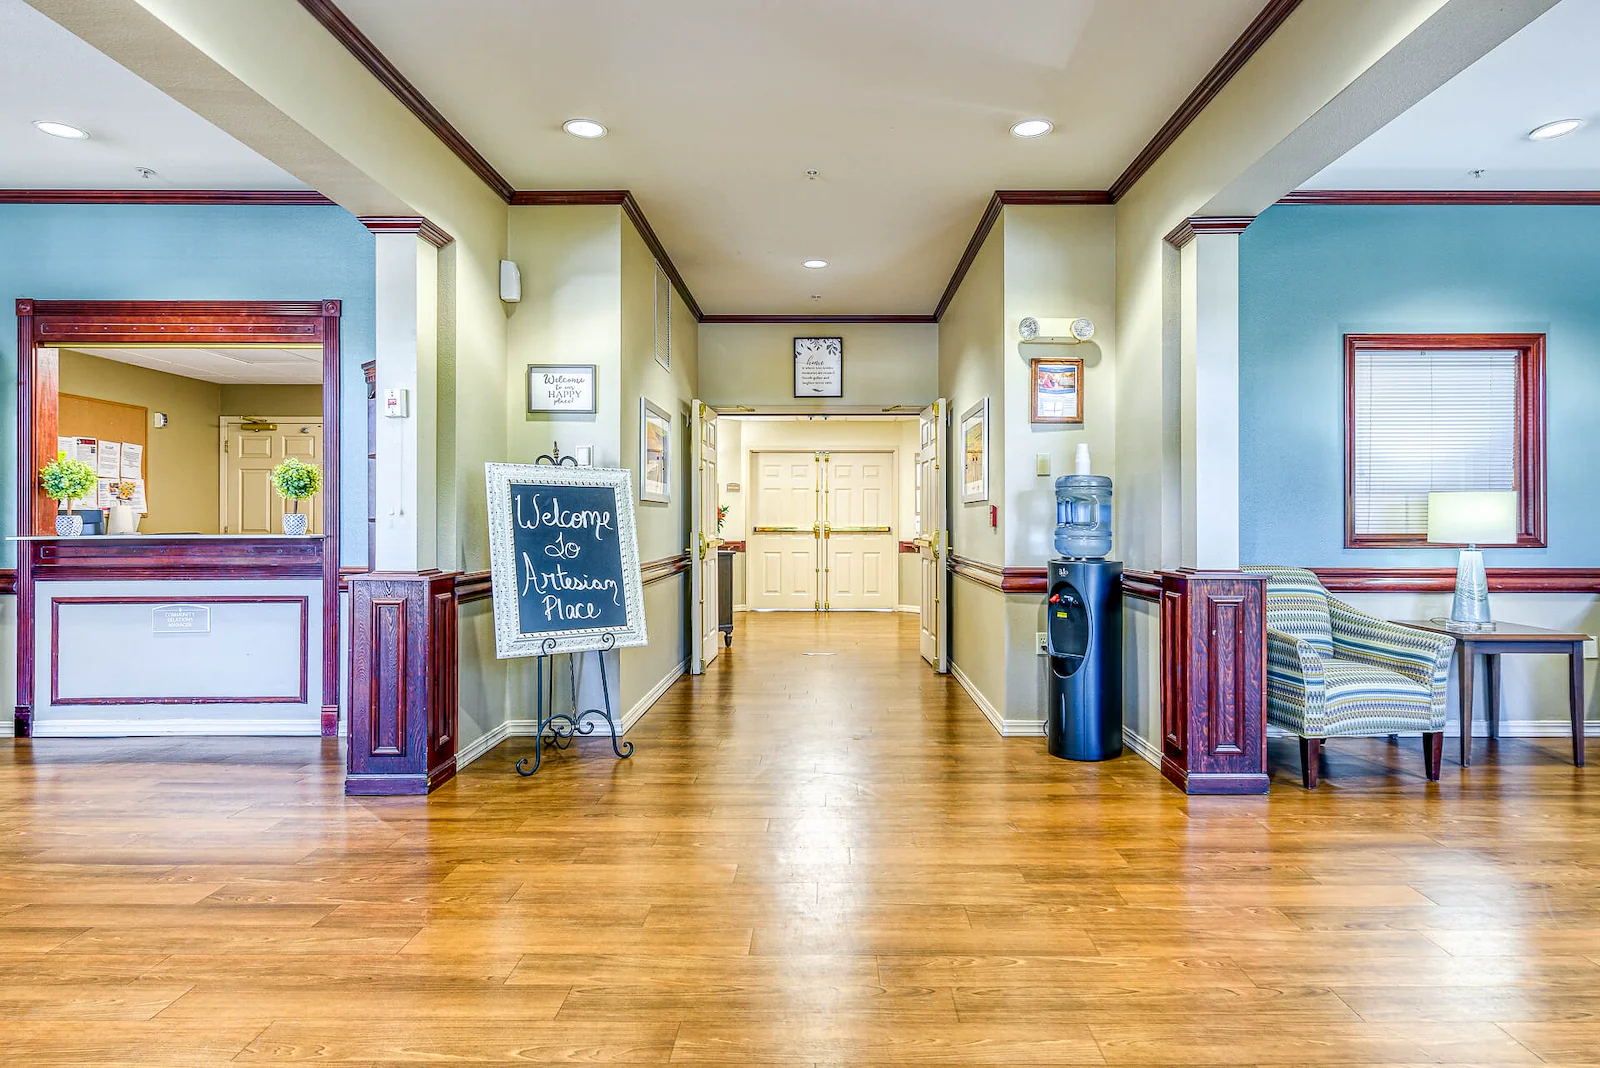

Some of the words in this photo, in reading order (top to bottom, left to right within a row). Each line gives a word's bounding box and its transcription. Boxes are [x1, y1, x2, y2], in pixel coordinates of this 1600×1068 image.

[543, 374, 585, 384] Welcome
[514, 493, 614, 540] Welcome
[521, 551, 621, 607] Artesian
[541, 594, 602, 621] Place
